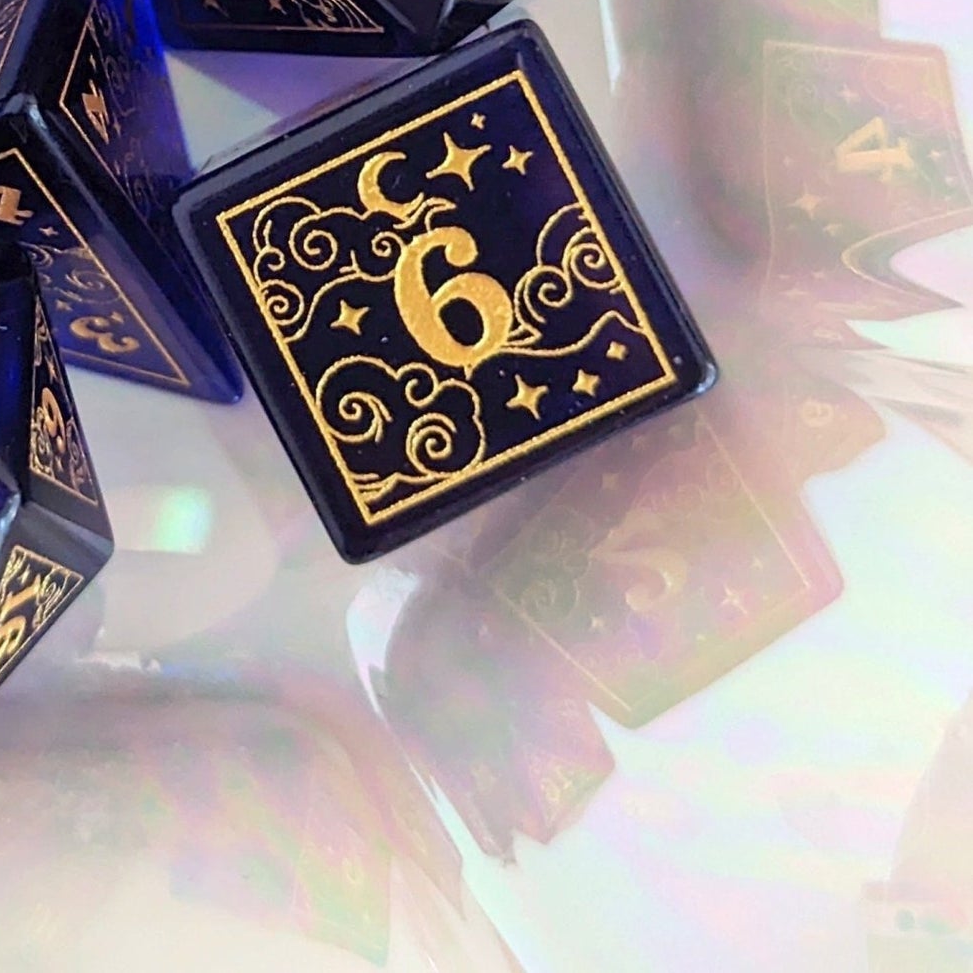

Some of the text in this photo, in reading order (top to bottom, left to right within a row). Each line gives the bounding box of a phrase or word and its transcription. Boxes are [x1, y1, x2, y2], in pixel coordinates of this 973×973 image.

[81, 80, 109, 144] 4
[394, 227, 513, 366] 6
[70, 316, 138, 353] 3
